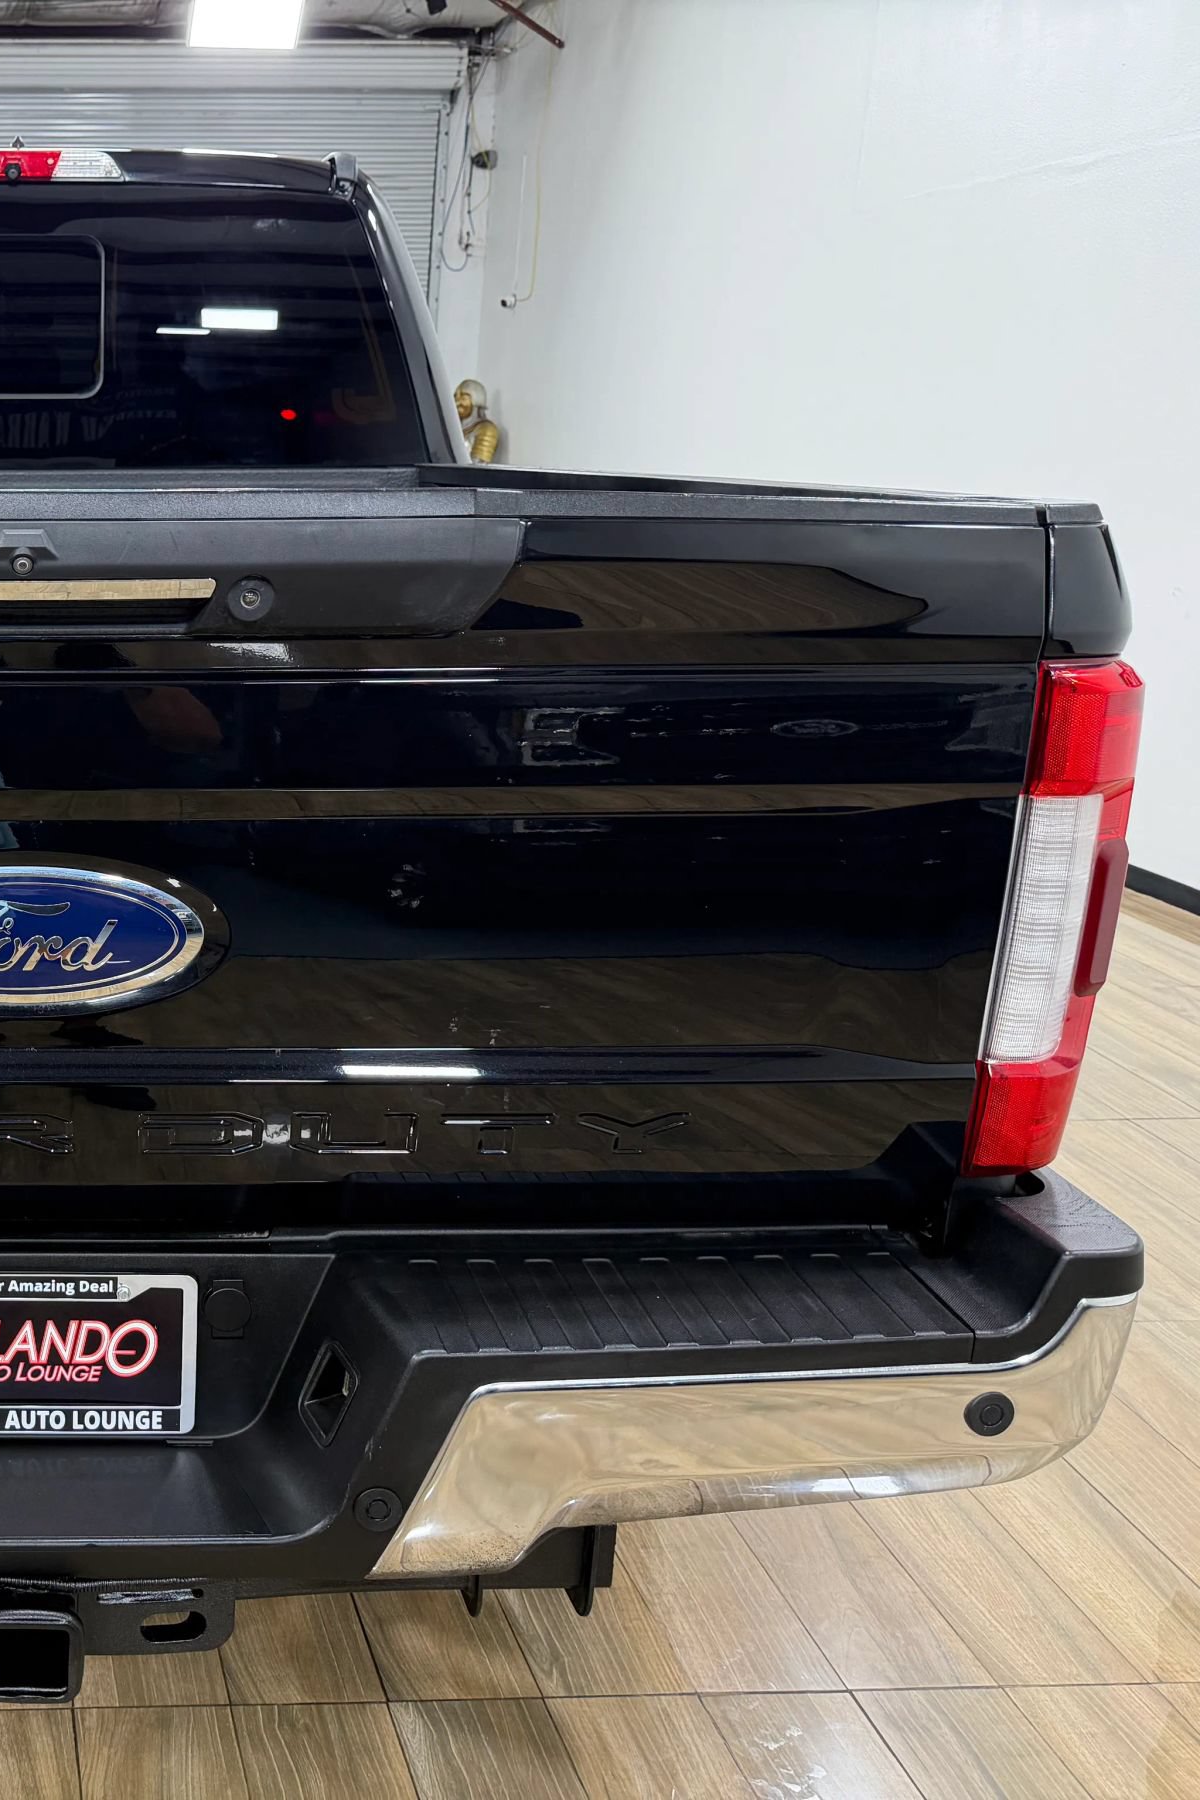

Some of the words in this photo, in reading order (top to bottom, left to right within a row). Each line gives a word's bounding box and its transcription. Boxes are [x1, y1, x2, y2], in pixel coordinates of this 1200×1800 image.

[137, 1110, 691, 1156] DUTY
[8, 1279, 75, 1296] Amazing
[79, 1279, 114, 1293] Deal
[15, 1361, 103, 1382] LOUNGE
[5, 1409, 68, 1430] AUTO
[72, 1409, 163, 1431] LOUNGE
